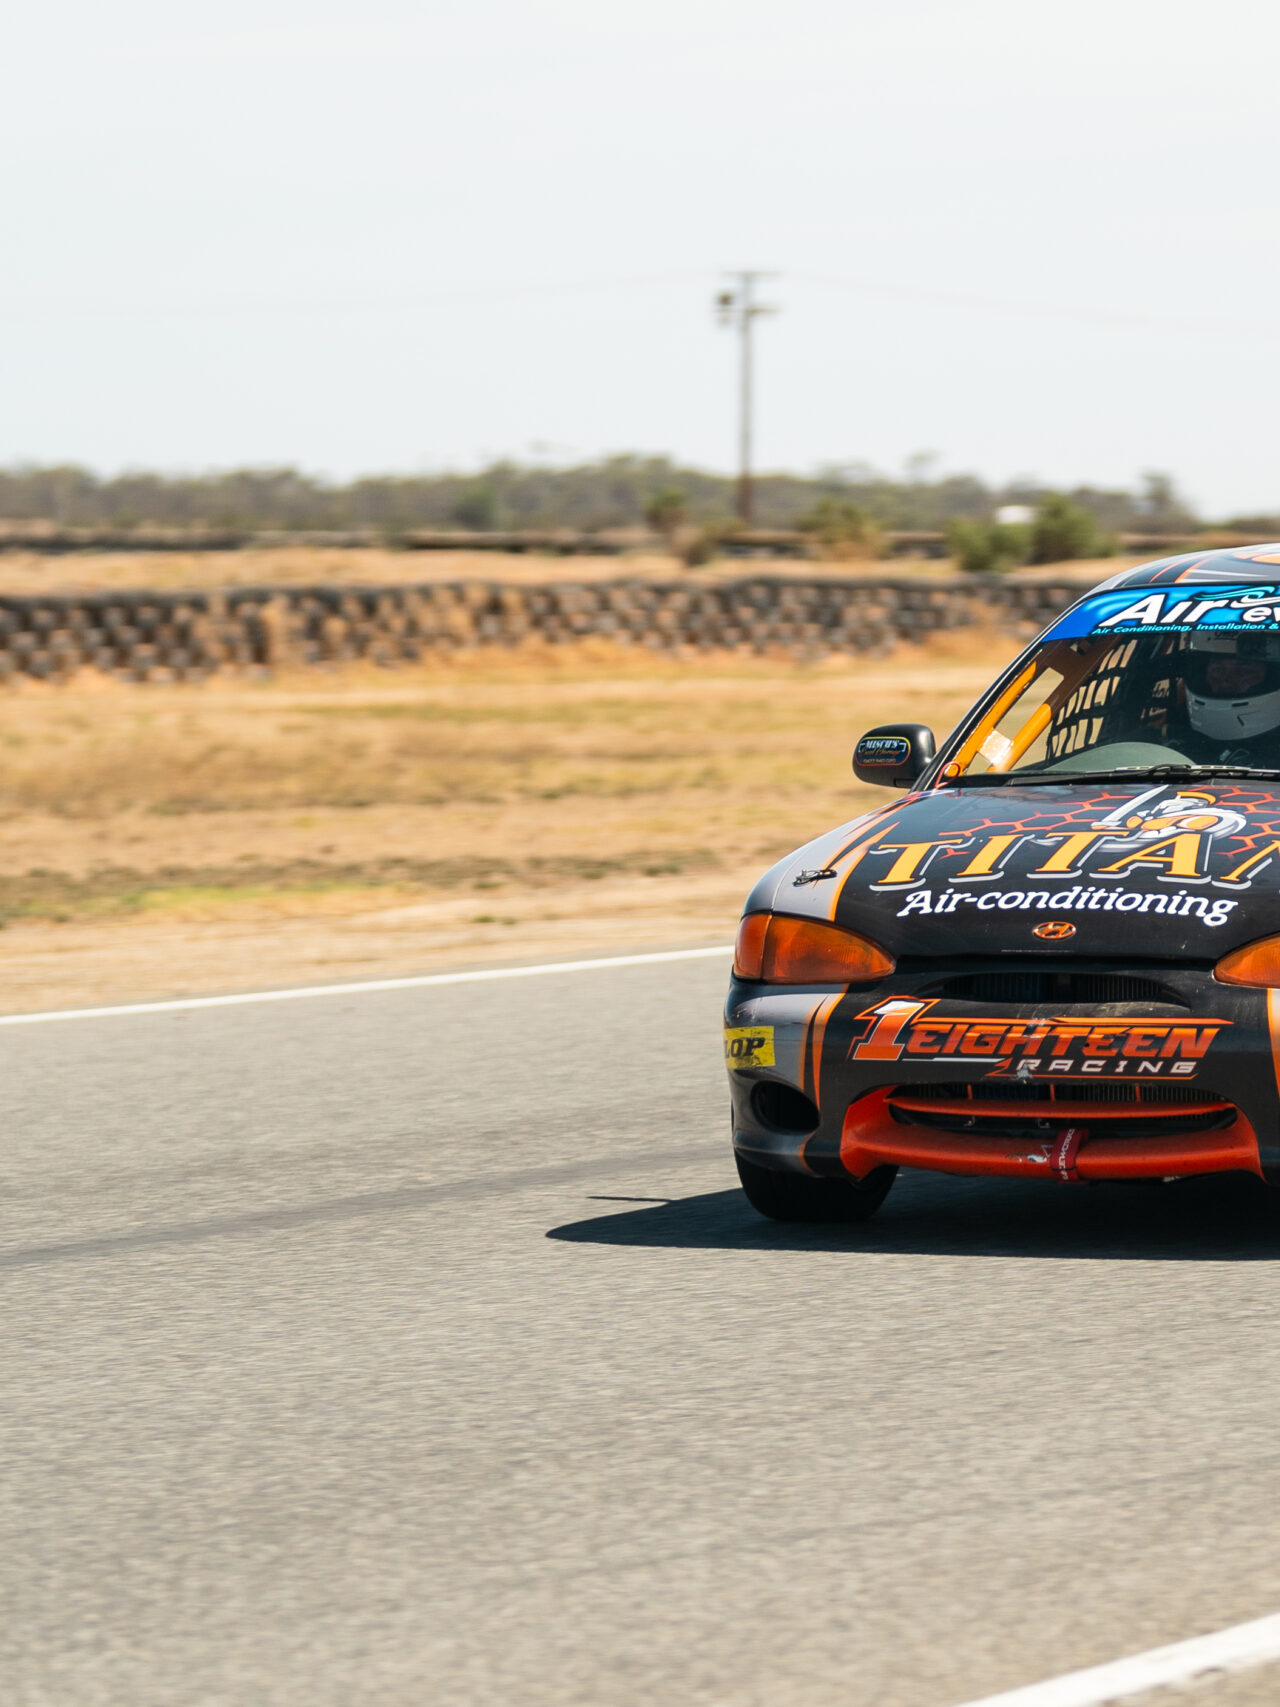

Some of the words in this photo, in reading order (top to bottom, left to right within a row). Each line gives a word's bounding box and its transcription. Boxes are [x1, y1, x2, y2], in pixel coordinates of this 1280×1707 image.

[1098, 592, 1229, 627] Air
[1196, 622, 1268, 631] Installation
[897, 887, 1239, 928] Air-conditioning
[1016, 1059, 1198, 1075] RACING
